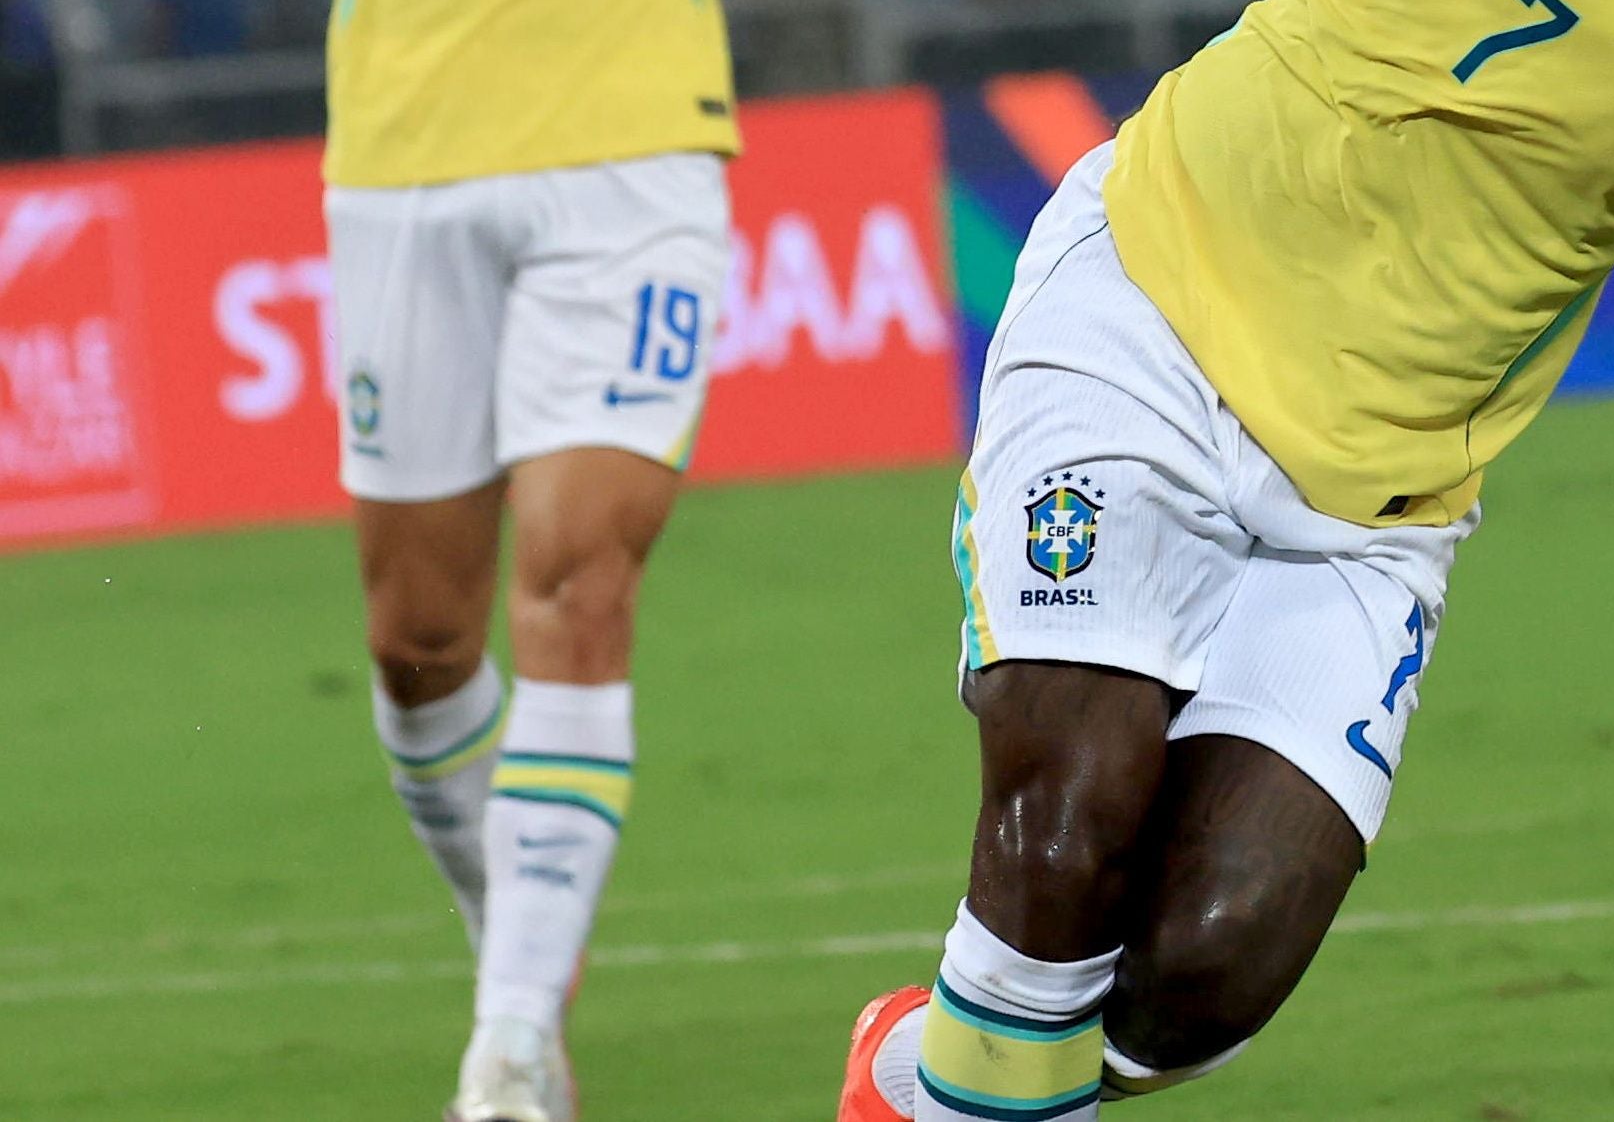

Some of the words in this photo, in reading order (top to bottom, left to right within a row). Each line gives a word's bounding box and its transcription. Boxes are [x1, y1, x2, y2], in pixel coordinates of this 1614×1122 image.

[630, 283, 700, 379] 19
[1046, 525, 1076, 537] CBF
[1020, 588, 1099, 607] BRASIL
[1381, 600, 1424, 715] 7
